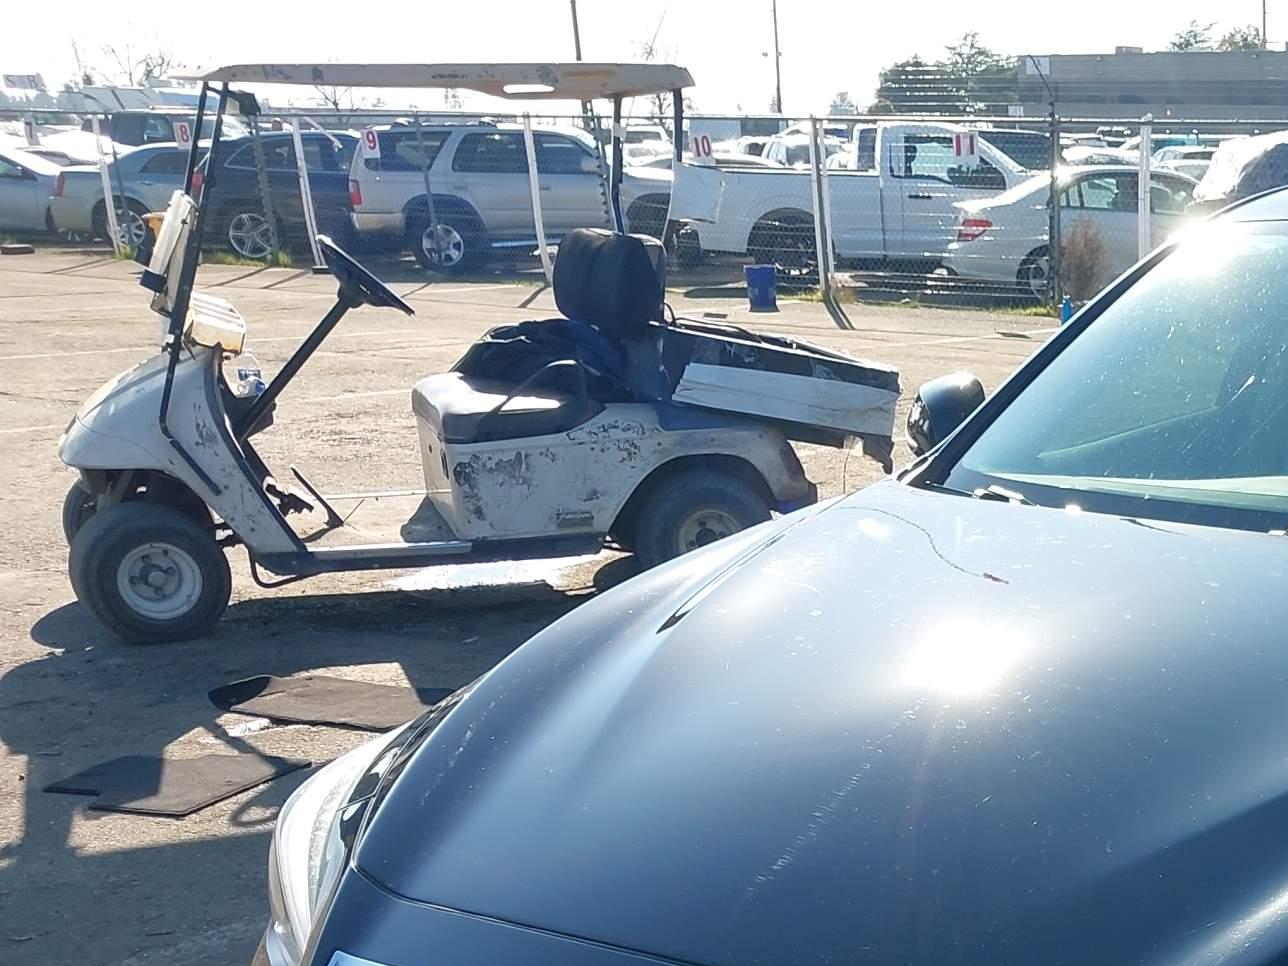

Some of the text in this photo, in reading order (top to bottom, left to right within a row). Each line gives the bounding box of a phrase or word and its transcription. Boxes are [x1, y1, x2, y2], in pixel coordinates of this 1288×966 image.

[180, 124, 189, 143] 8
[366, 131, 377, 150] 9
[694, 135, 711, 157] 10
[955, 135, 975, 156] 11
